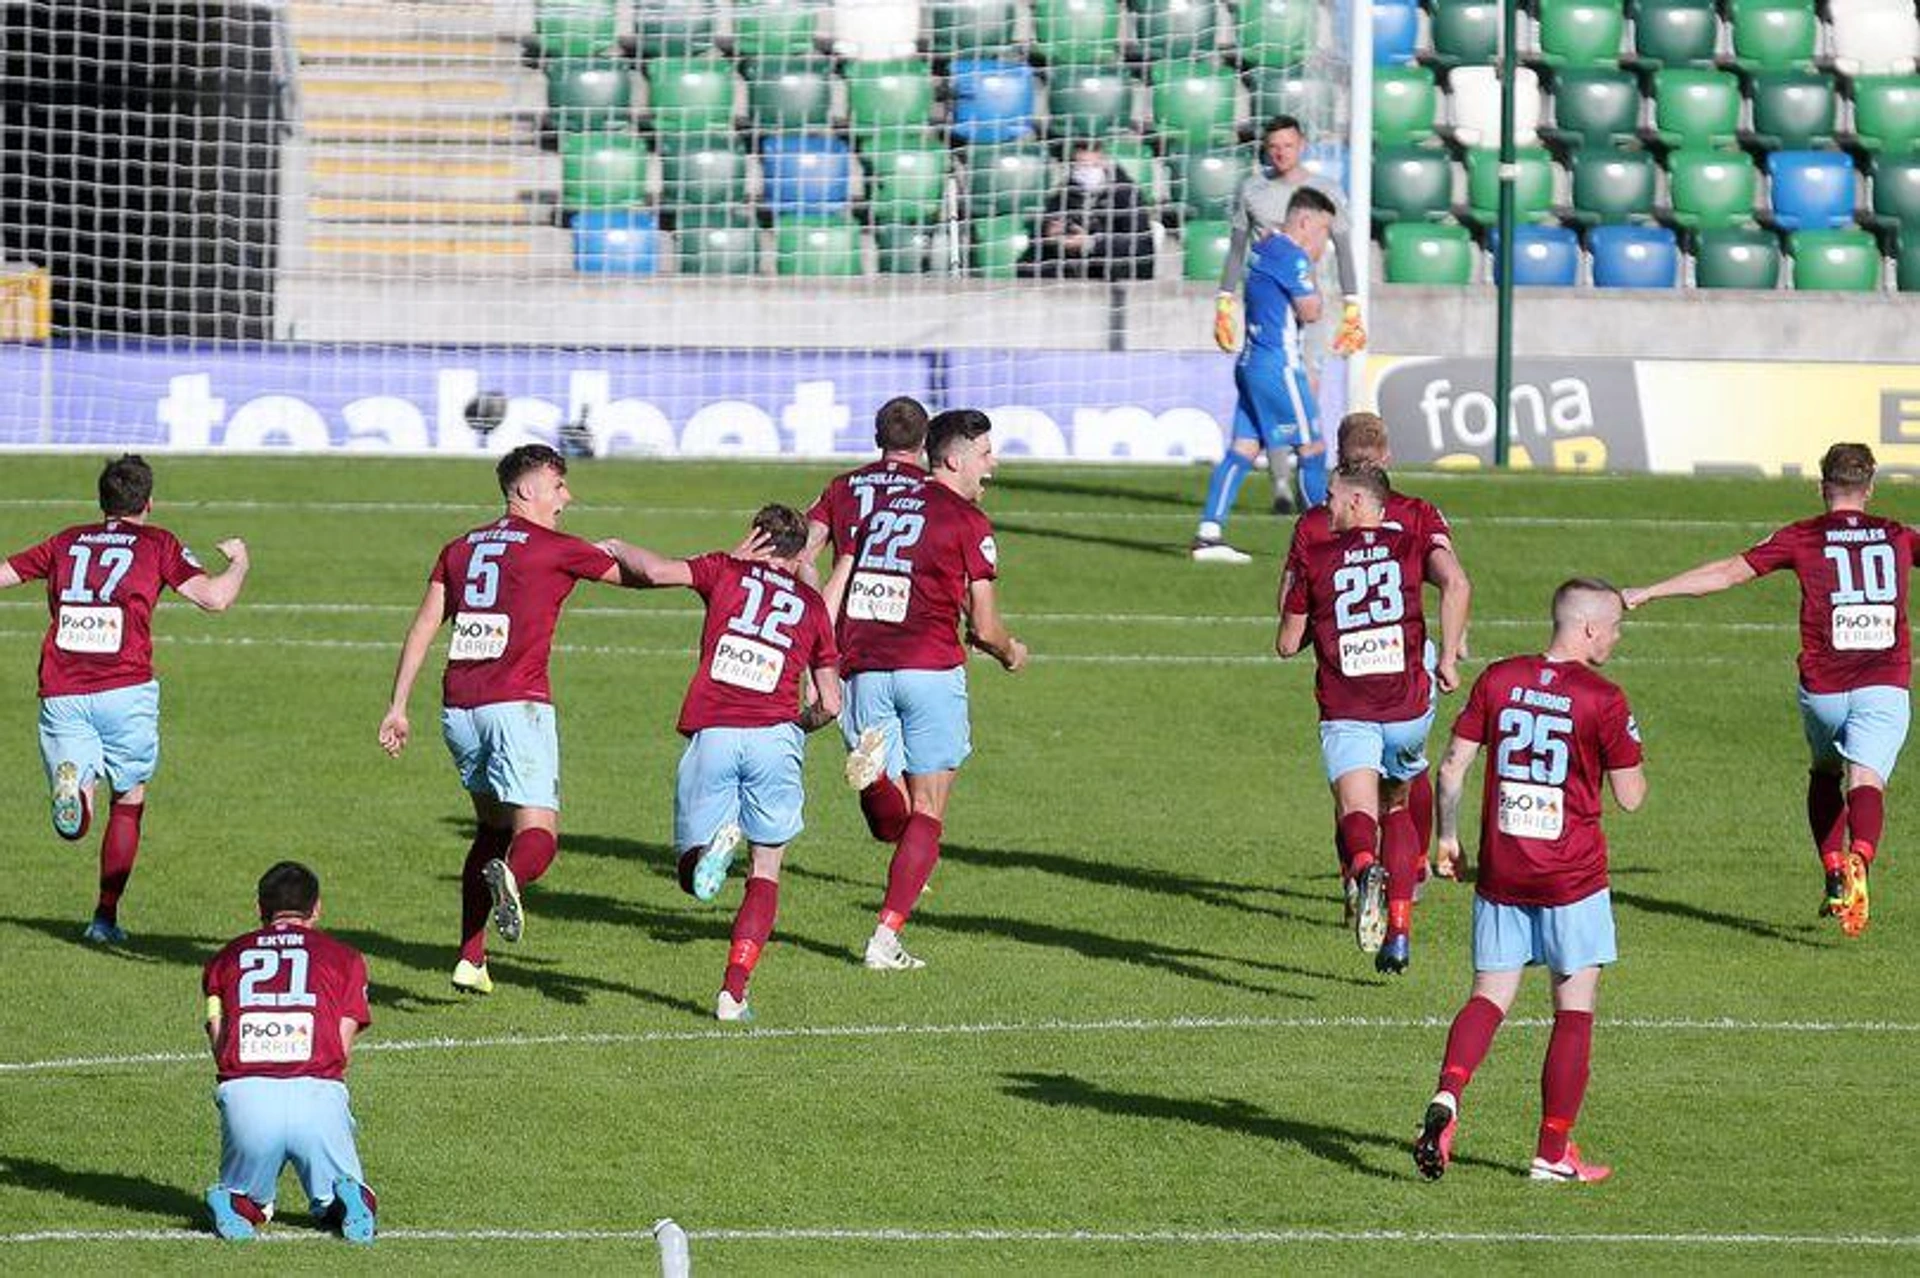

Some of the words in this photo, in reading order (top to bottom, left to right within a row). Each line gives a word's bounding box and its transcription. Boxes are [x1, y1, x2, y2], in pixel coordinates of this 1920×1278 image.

[1420, 378, 1594, 450] fona
[60, 544, 135, 603] 17
[464, 542, 508, 608] 5
[858, 510, 926, 574] 22
[1823, 544, 1898, 606] 10
[727, 576, 806, 649] 12
[1334, 560, 1405, 630] 23
[1497, 707, 1574, 786] 25
[239, 947, 318, 1008] 21
